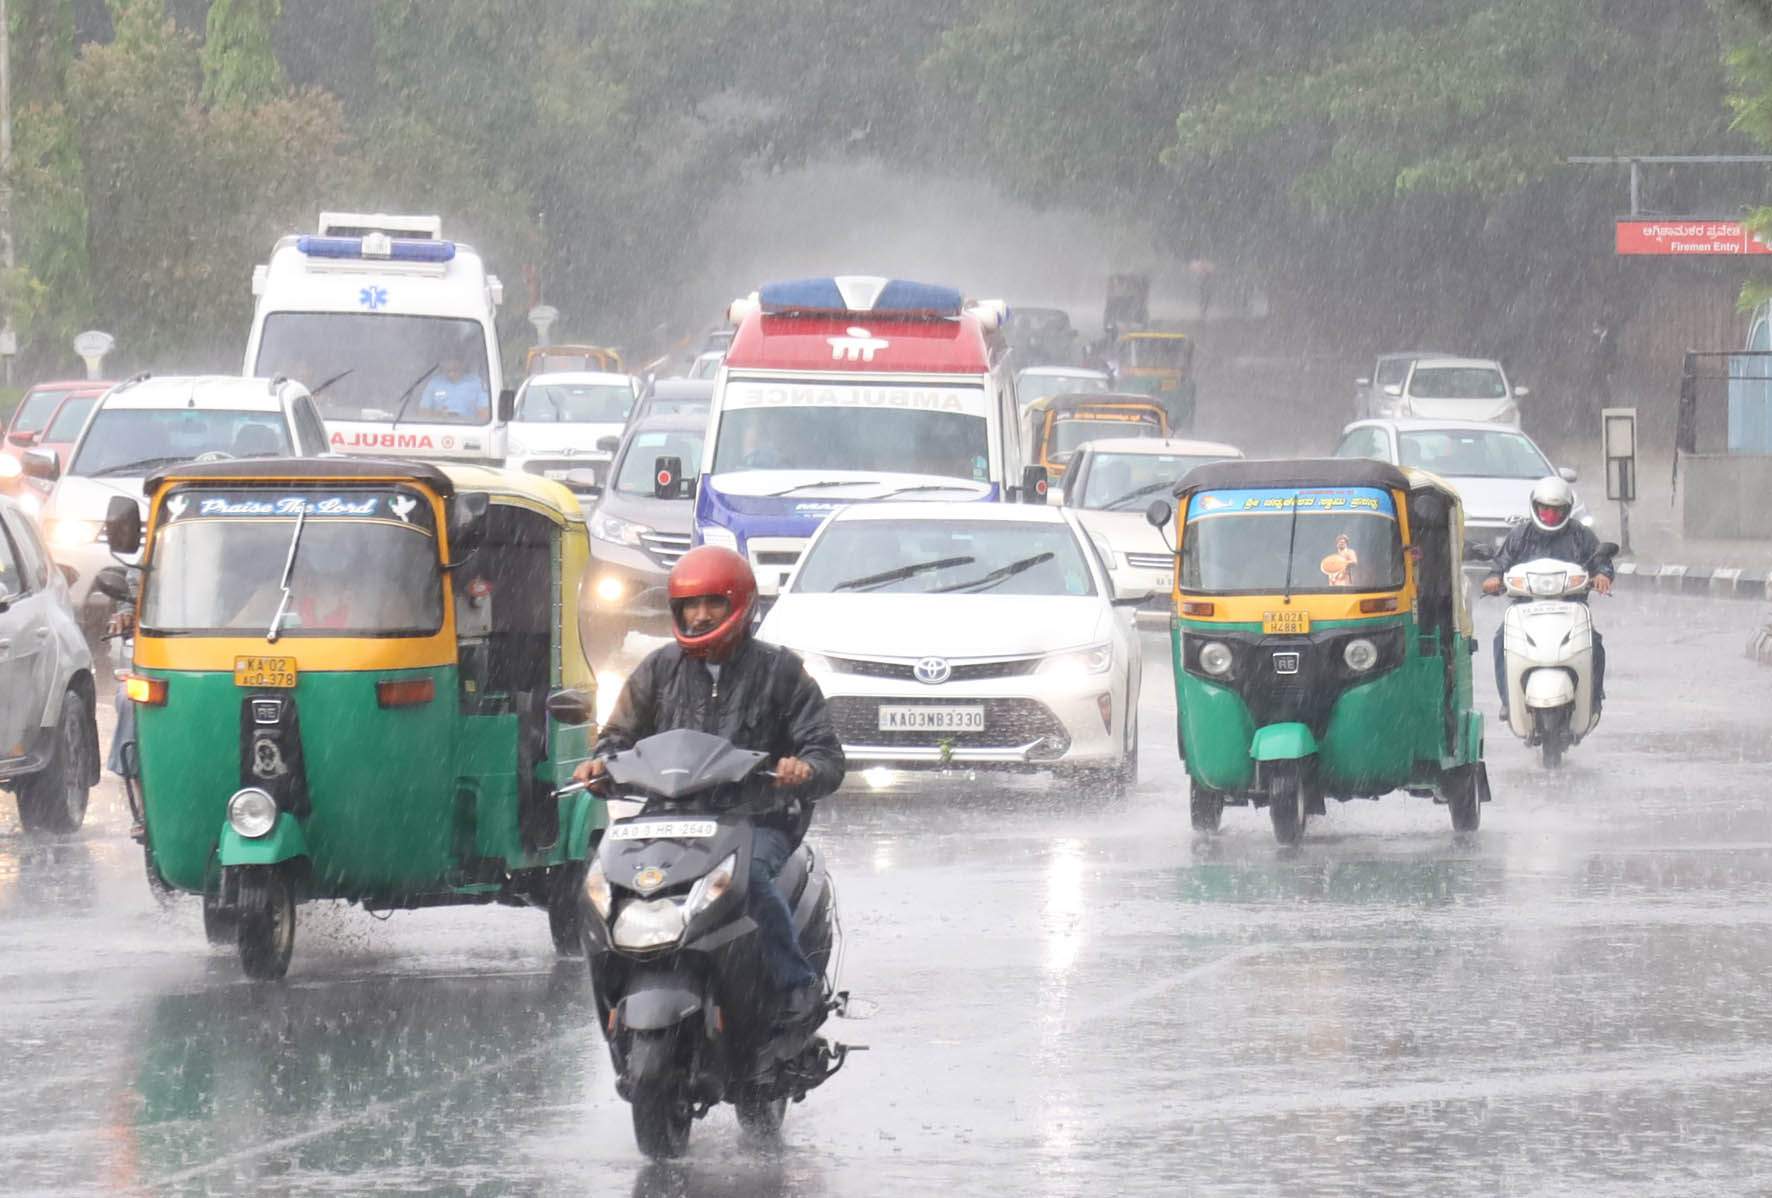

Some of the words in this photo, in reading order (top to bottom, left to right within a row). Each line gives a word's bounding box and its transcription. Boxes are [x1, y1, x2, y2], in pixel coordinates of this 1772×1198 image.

[1713, 241, 1740, 253] Entry
[201, 498, 274, 515] Praise
[275, 497, 314, 515] The
[317, 497, 378, 515] Lord
[1278, 659, 1295, 669] RE
[889, 712, 982, 727] KA03NB3330
